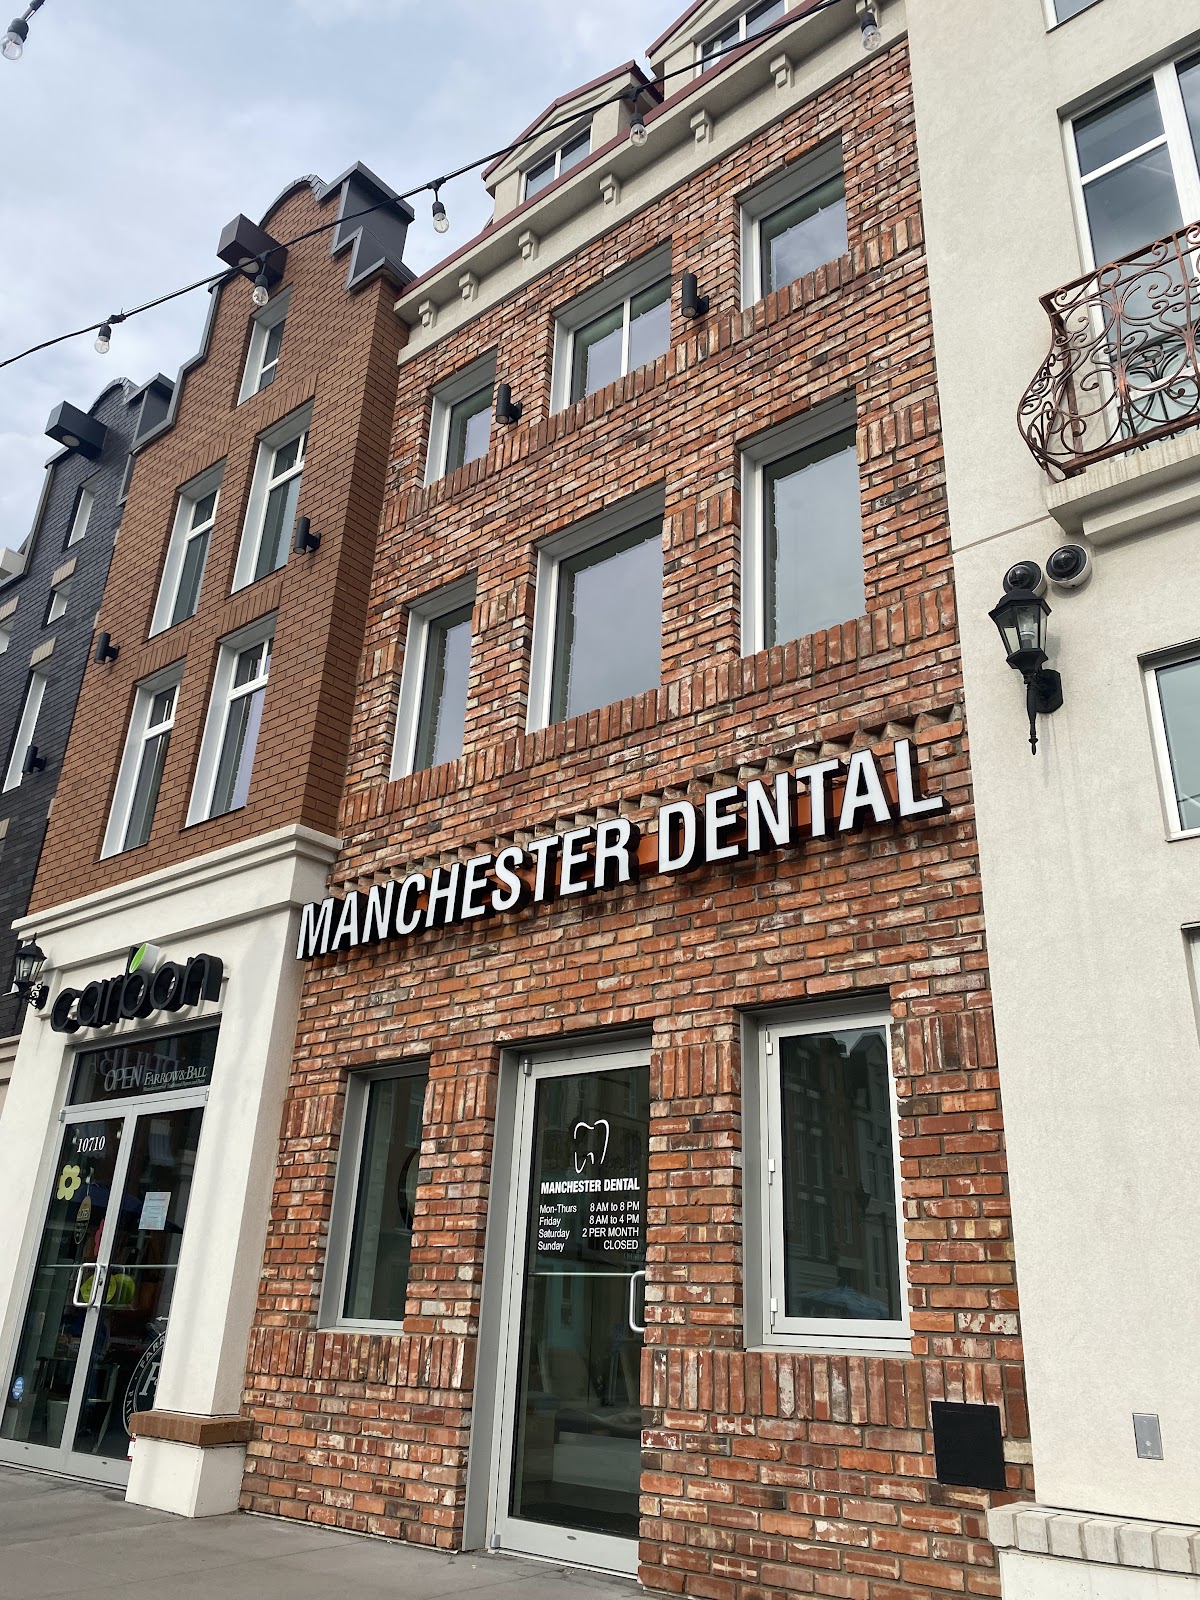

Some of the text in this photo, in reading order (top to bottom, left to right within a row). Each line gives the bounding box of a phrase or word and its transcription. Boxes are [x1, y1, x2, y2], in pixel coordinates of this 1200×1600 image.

[296, 738, 948, 960] MANCHESTER DENTAL
[51, 945, 223, 1033] carbon
[104, 1065, 143, 1092] OPEN
[77, 1136, 105, 1153] 10710
[541, 1177, 640, 1194] MANCHESTER DENTAL
[539, 1201, 640, 1214] Mon-Thurs 8 AM to 8 PM
[539, 1214, 640, 1227] Friday 8 AM to 4 PM
[539, 1227, 639, 1240] Saturday 2 PER MONTH
[538, 1239, 639, 1252] Sunday CLOSED
